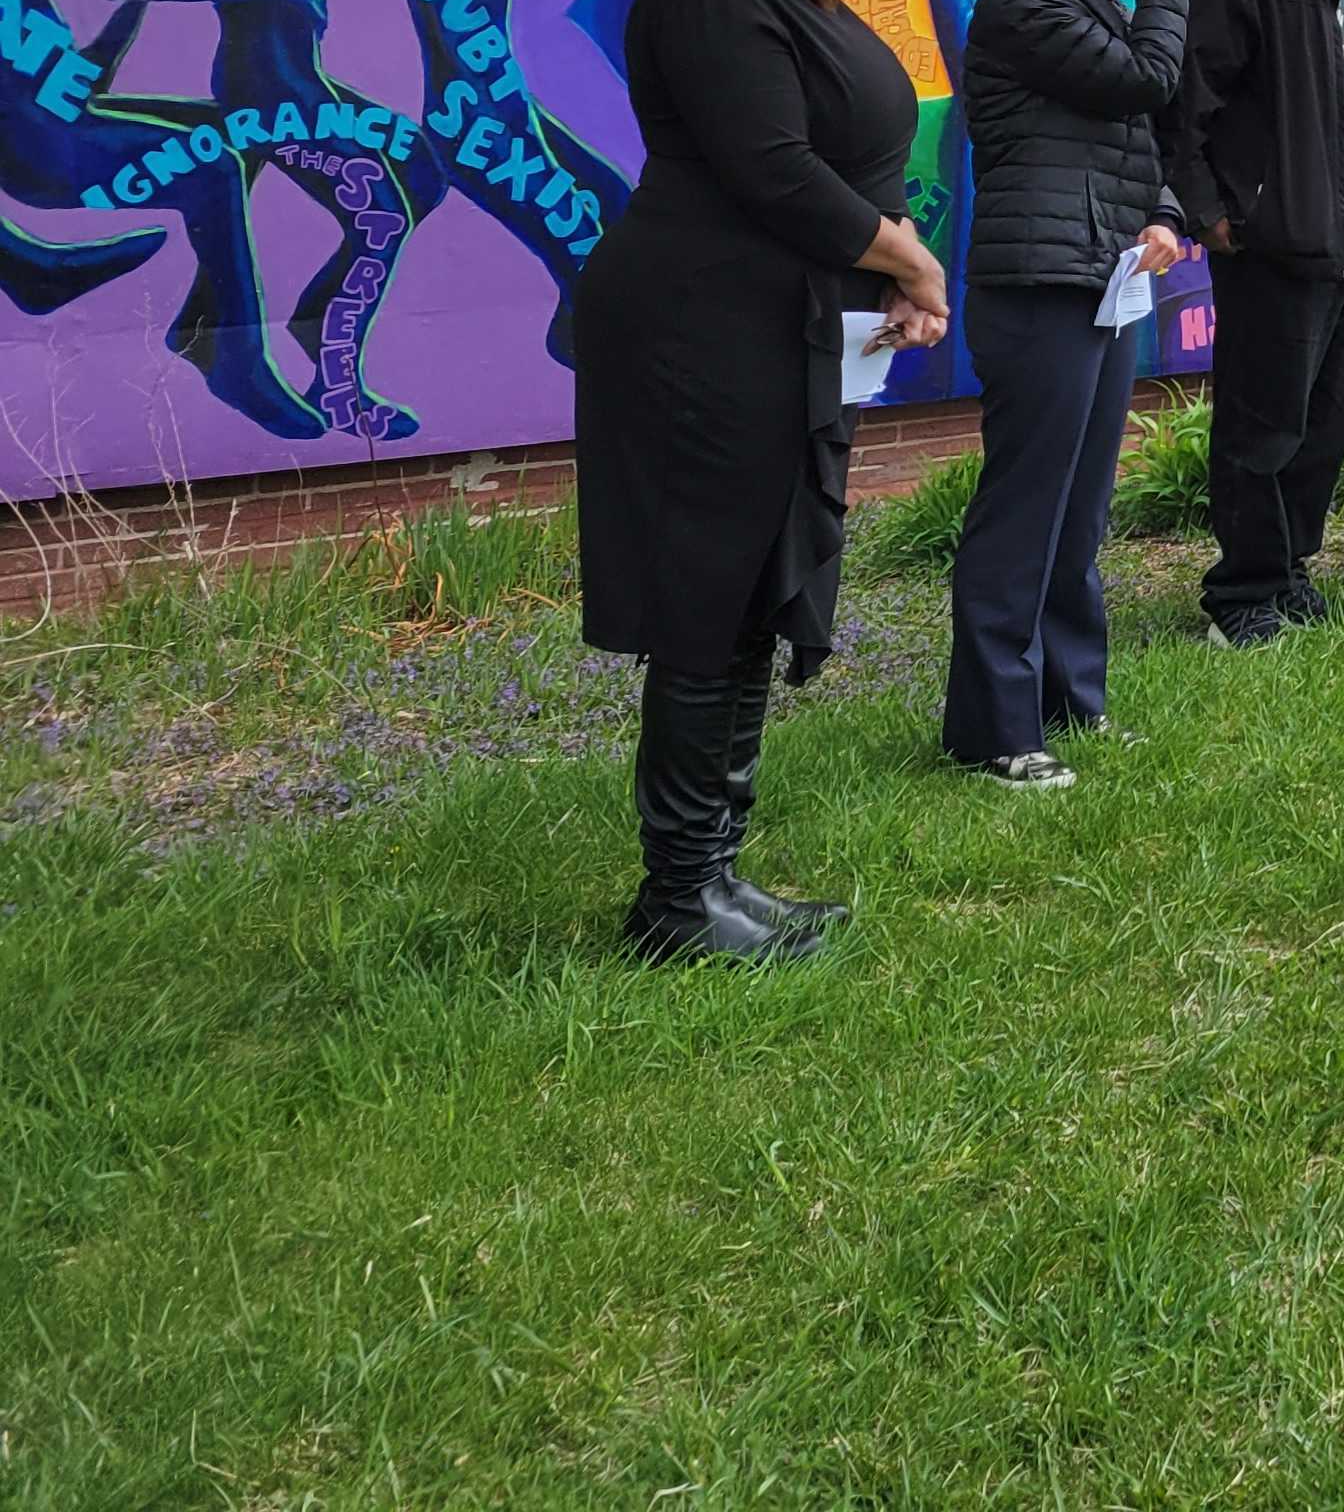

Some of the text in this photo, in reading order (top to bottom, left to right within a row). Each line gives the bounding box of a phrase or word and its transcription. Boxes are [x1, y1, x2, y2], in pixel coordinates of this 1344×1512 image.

[80, 102, 418, 210] IGNORANCE
[276, 145, 343, 177] THE
[320, 157, 406, 439] STREETS
